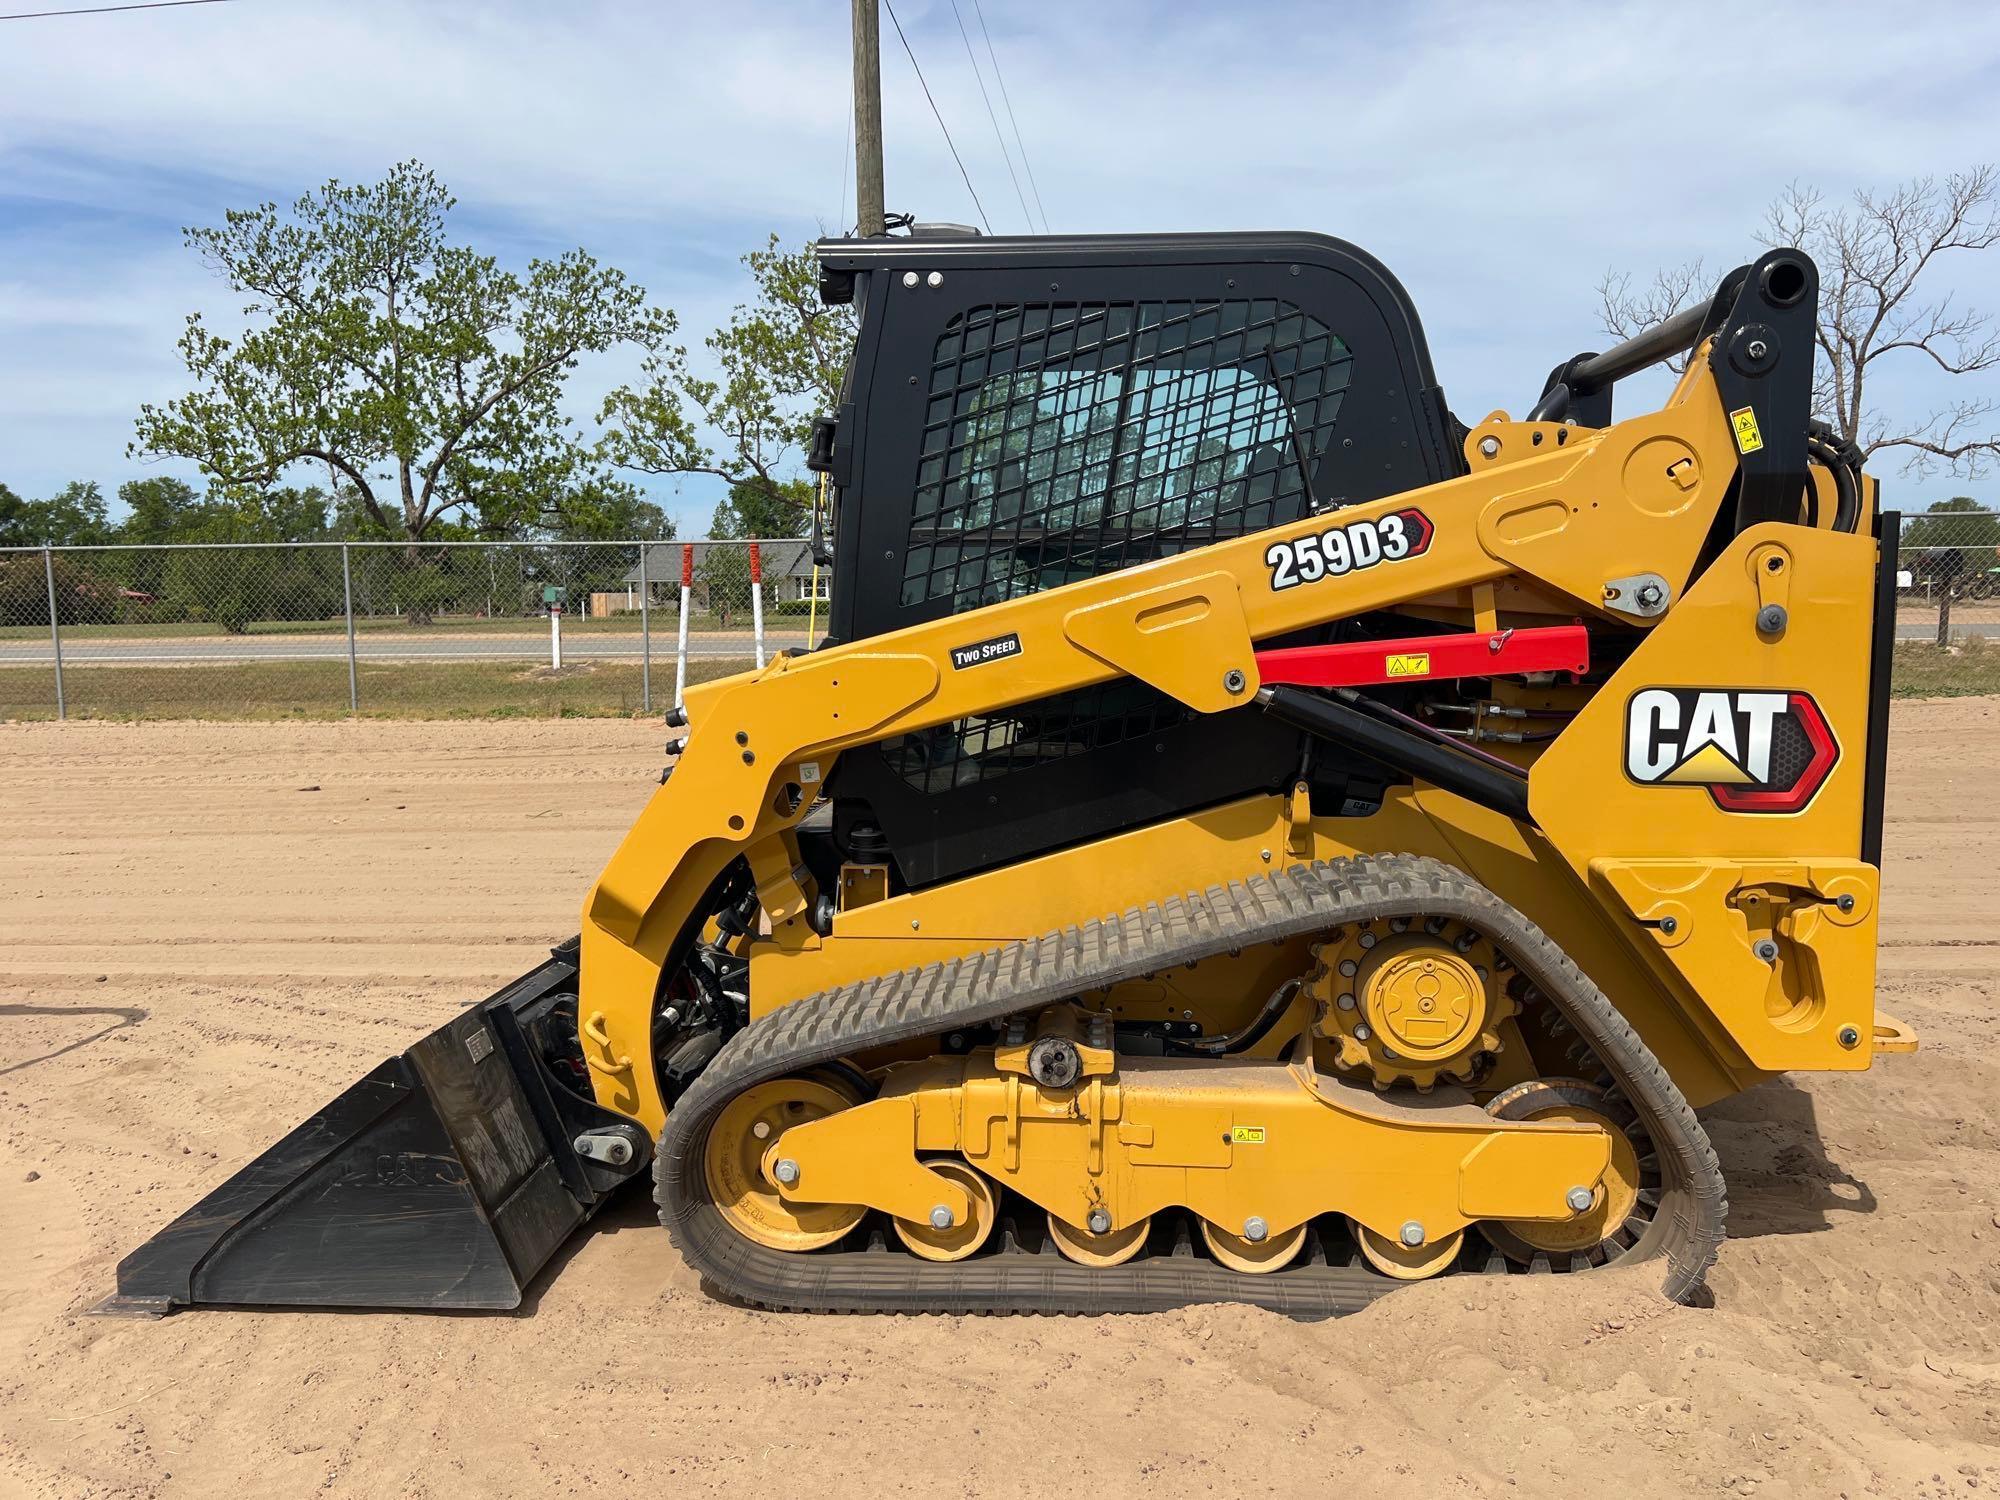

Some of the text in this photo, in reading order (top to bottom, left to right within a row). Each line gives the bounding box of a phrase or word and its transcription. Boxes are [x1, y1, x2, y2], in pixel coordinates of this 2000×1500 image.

[1267, 515, 1409, 589] 259D3
[955, 640, 1016, 665] TWO SPEED
[1628, 689, 1788, 784] CAT
[1352, 801, 1370, 811] CAT
